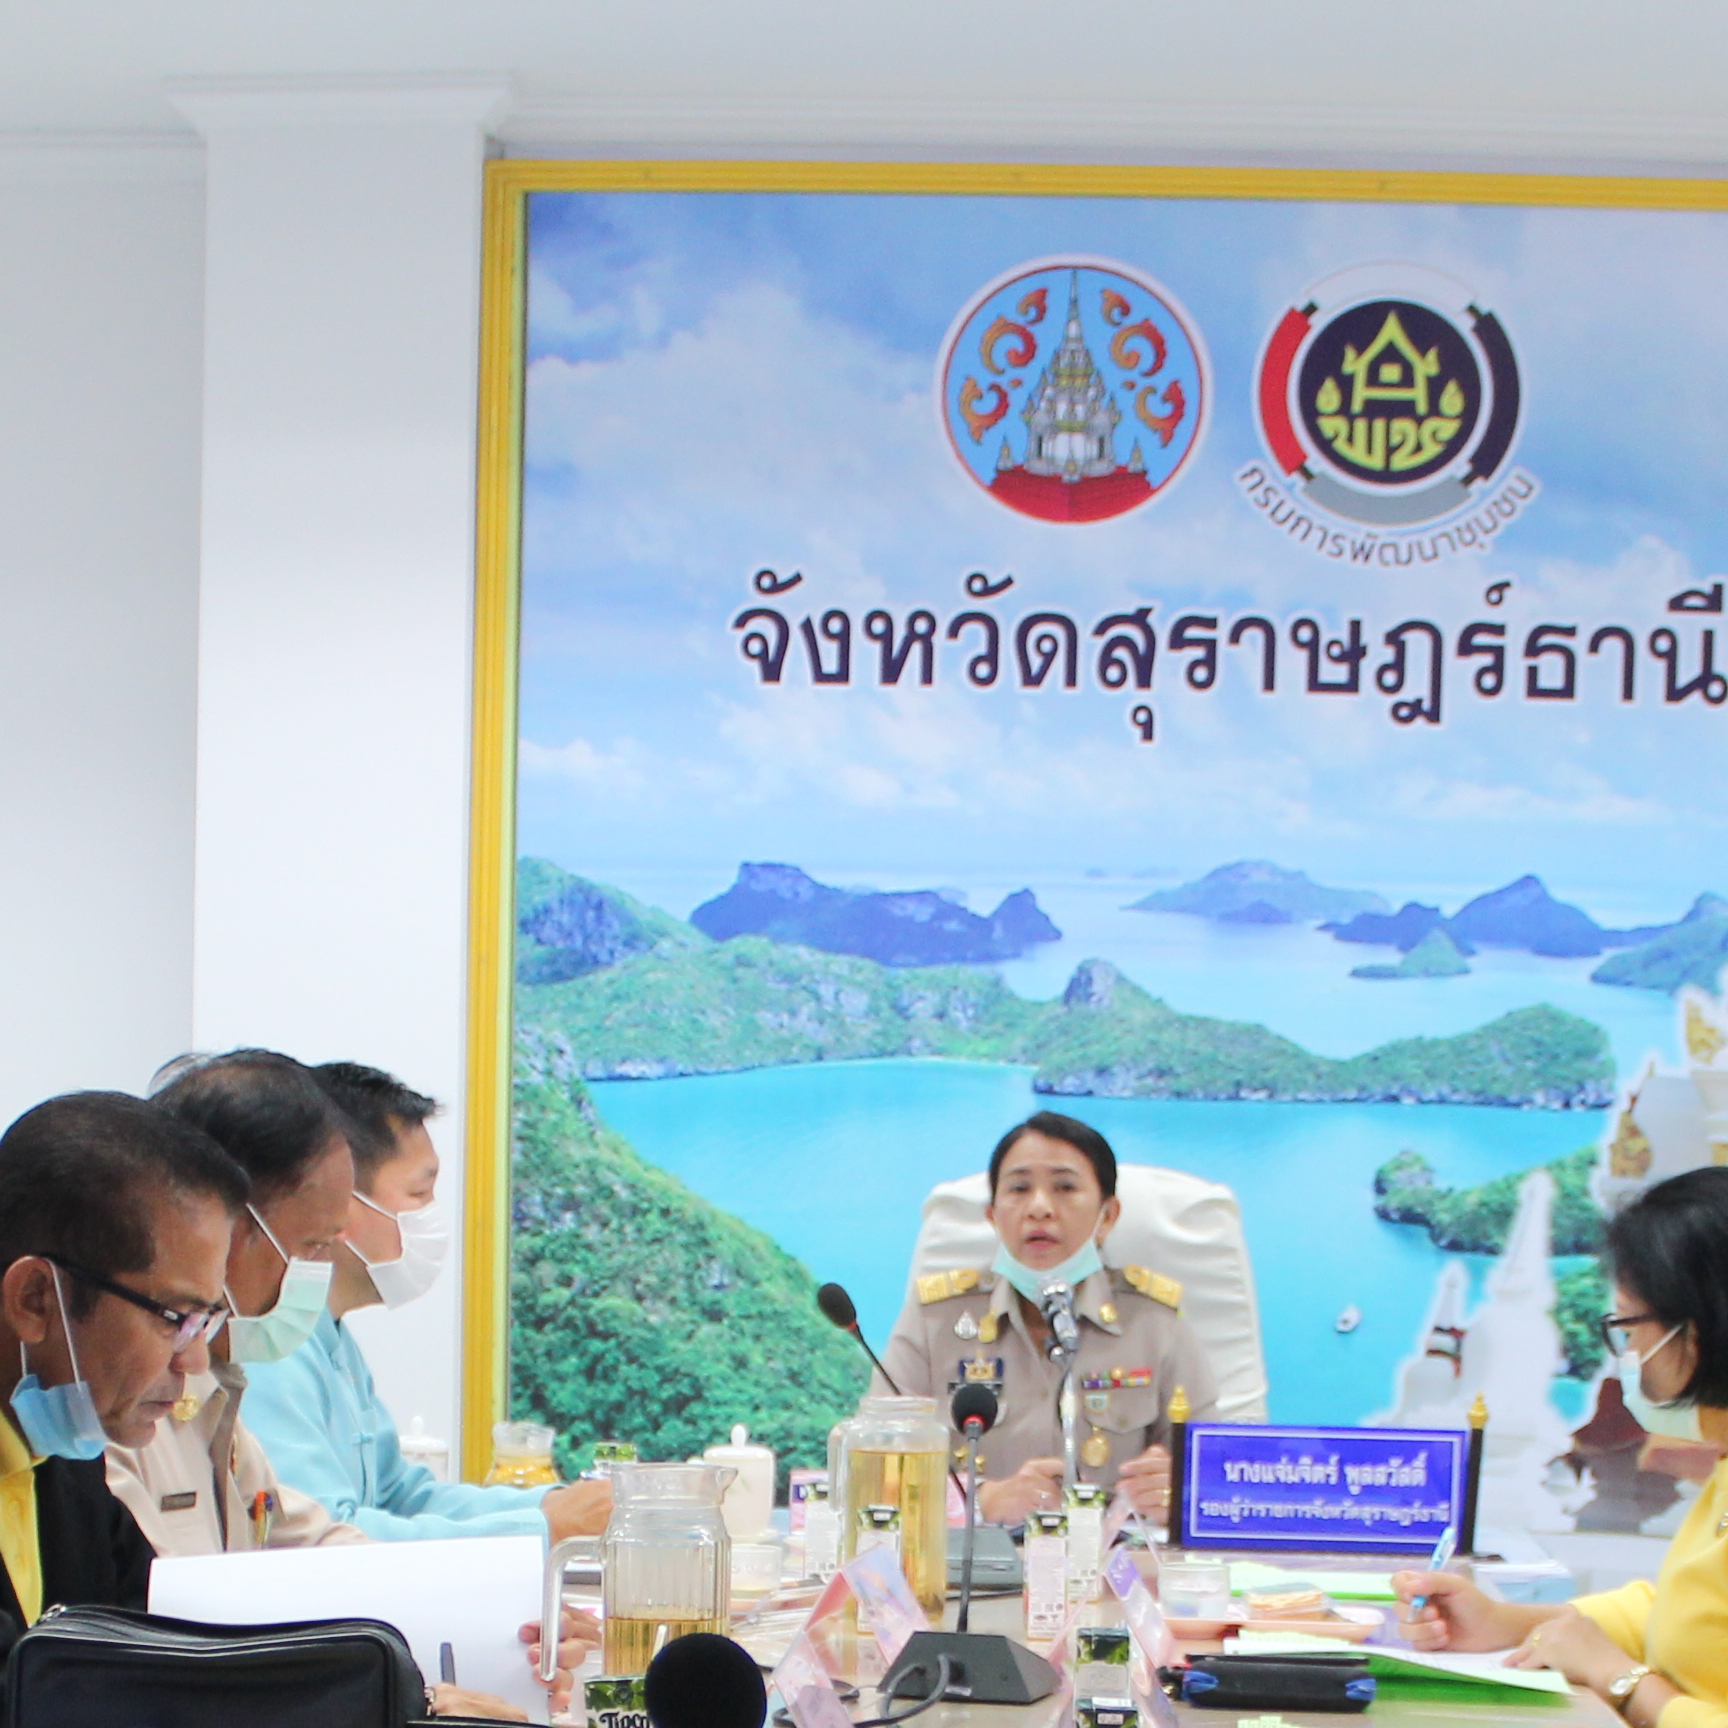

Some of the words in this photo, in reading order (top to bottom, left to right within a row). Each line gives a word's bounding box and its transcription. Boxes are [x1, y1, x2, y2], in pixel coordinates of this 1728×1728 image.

[1239, 465, 1536, 566] กรมการพัฒนาชุมชน
